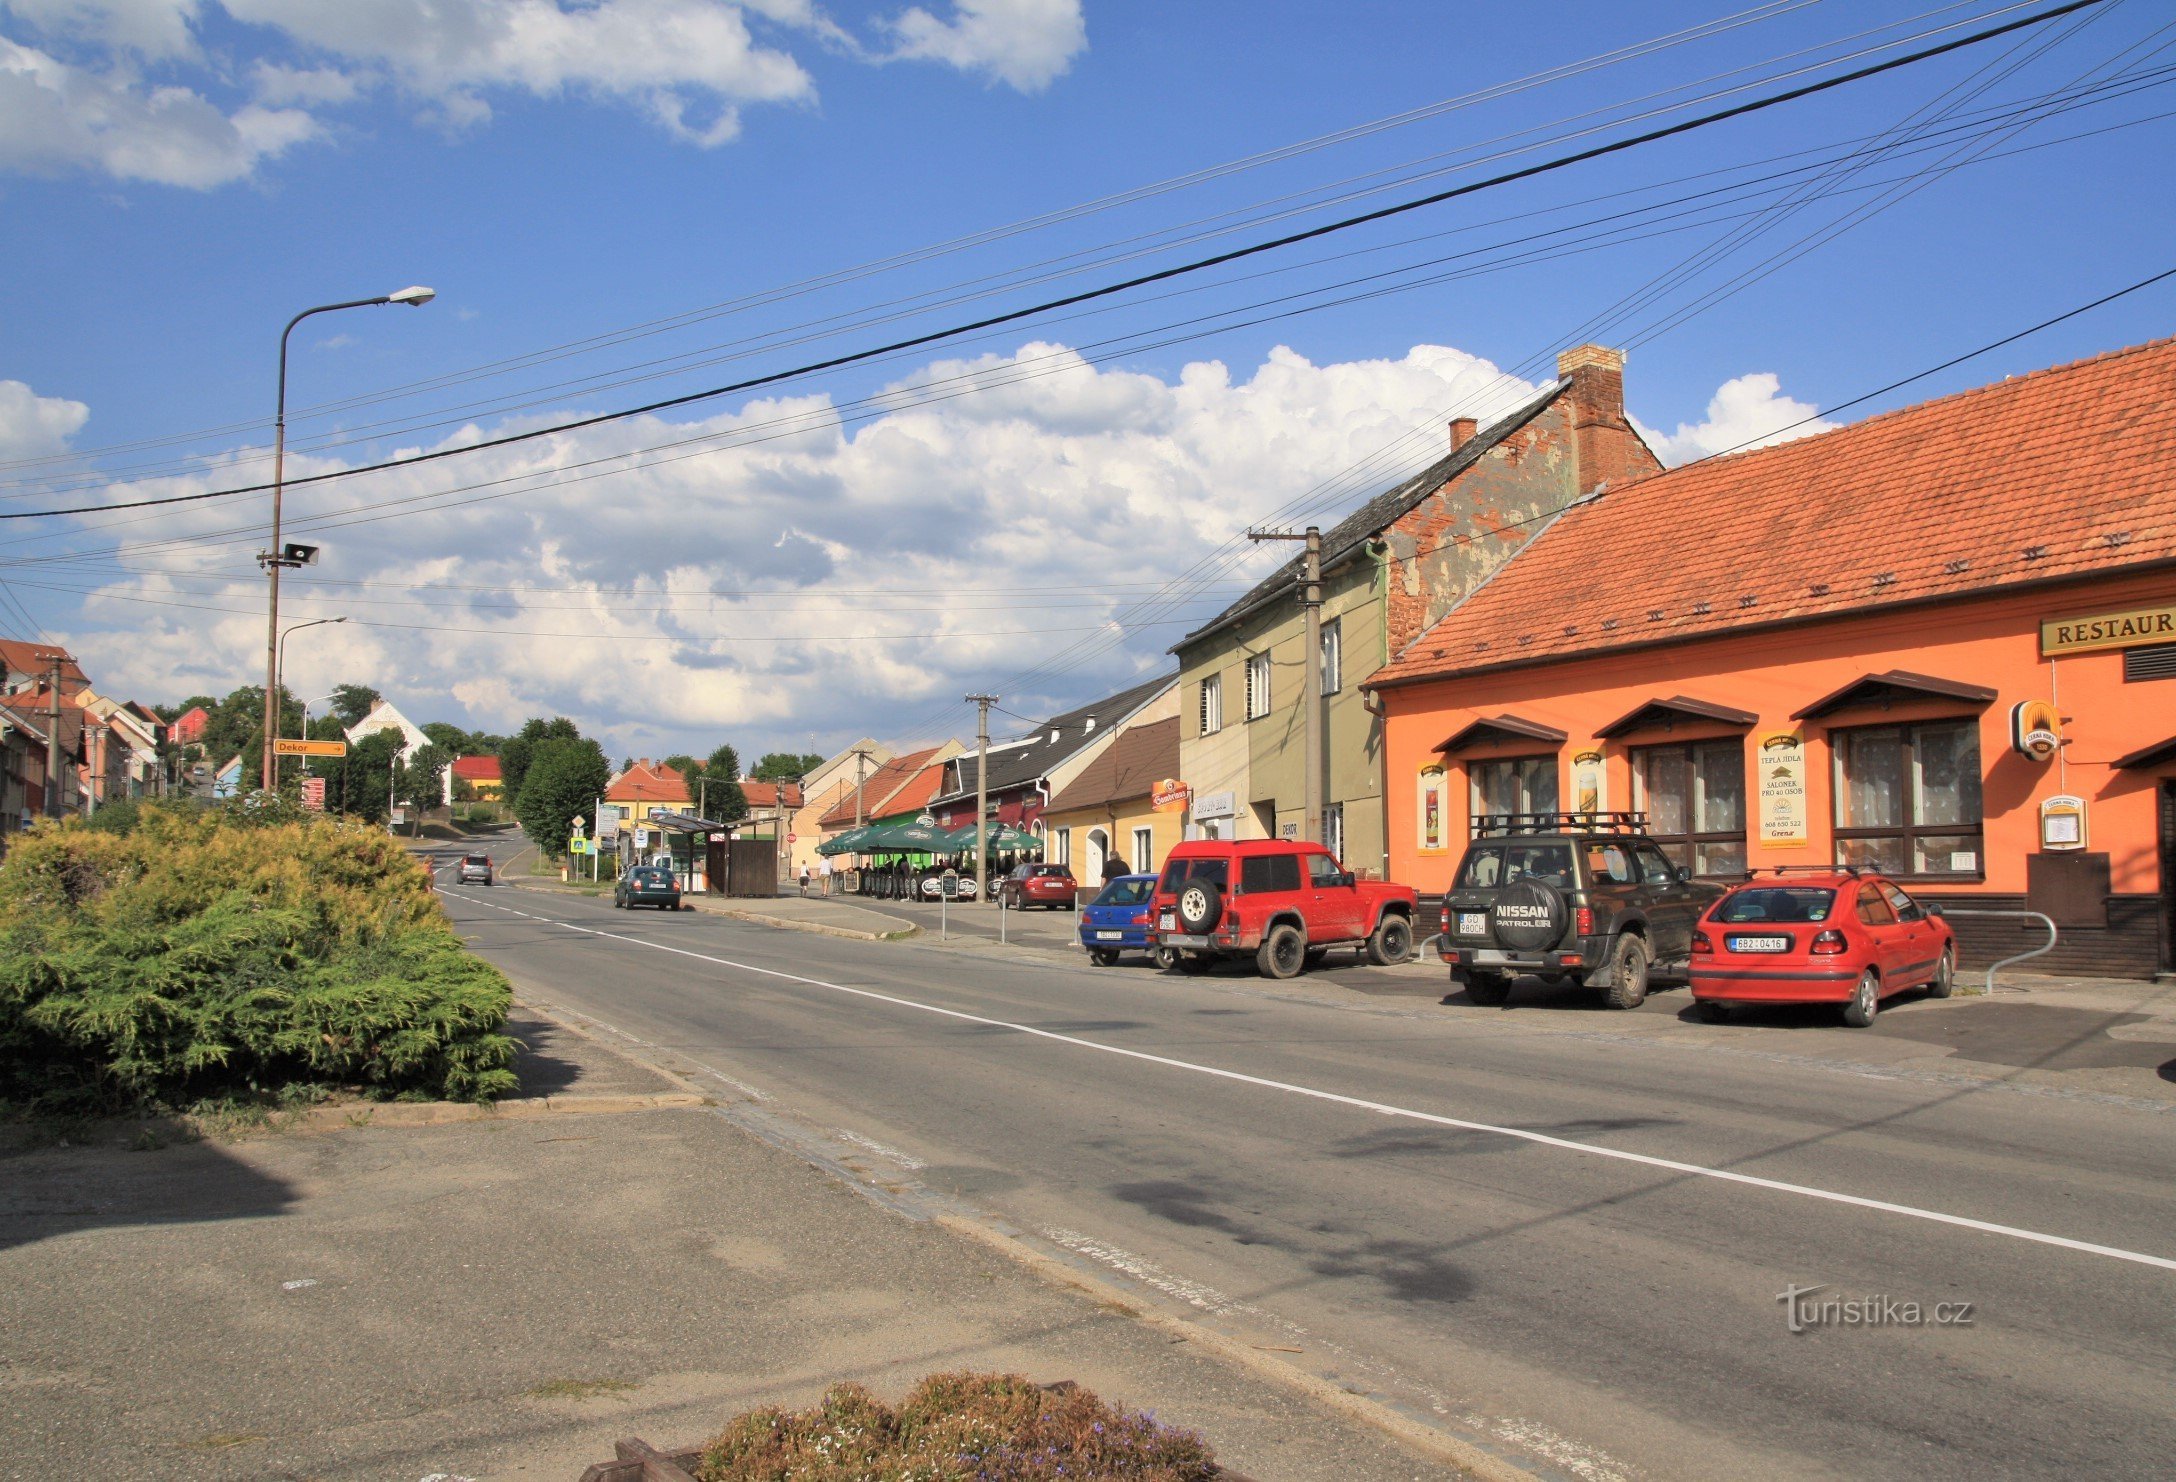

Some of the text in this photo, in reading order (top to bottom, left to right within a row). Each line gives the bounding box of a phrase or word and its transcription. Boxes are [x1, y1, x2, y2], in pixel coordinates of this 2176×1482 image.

[2056, 613, 2174, 644] RESTAUR
[279, 743, 308, 752] Dekor
[1282, 823, 1298, 835] DEKOR
[1496, 905, 1549, 918] NISSAN
[1467, 914, 1479, 924] GD
[1496, 920, 1535, 928] PATROL
[1760, 939, 1781, 948] 0416
